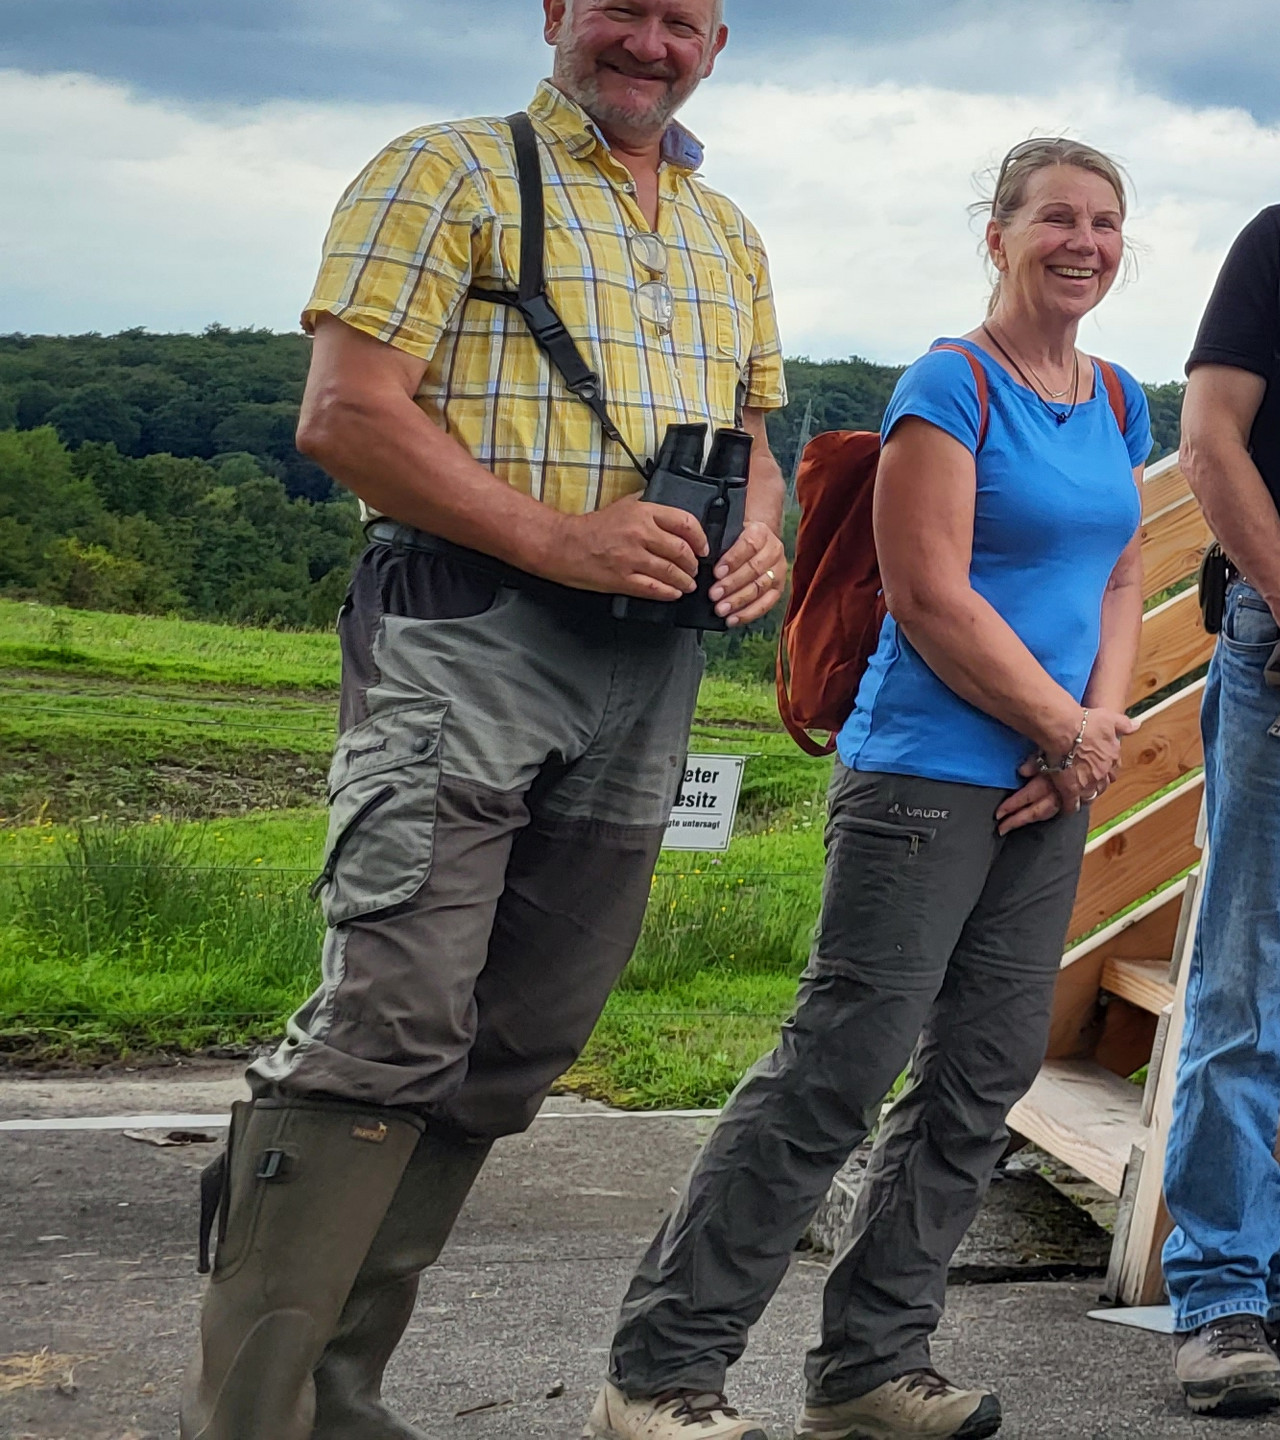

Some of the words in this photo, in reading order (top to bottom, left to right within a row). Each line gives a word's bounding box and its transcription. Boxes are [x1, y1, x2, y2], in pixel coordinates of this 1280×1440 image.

[684, 767, 719, 784] eter
[675, 791, 718, 808] esitz
[906, 806, 949, 819] VAUDE
[682, 820, 721, 830] untersagt
